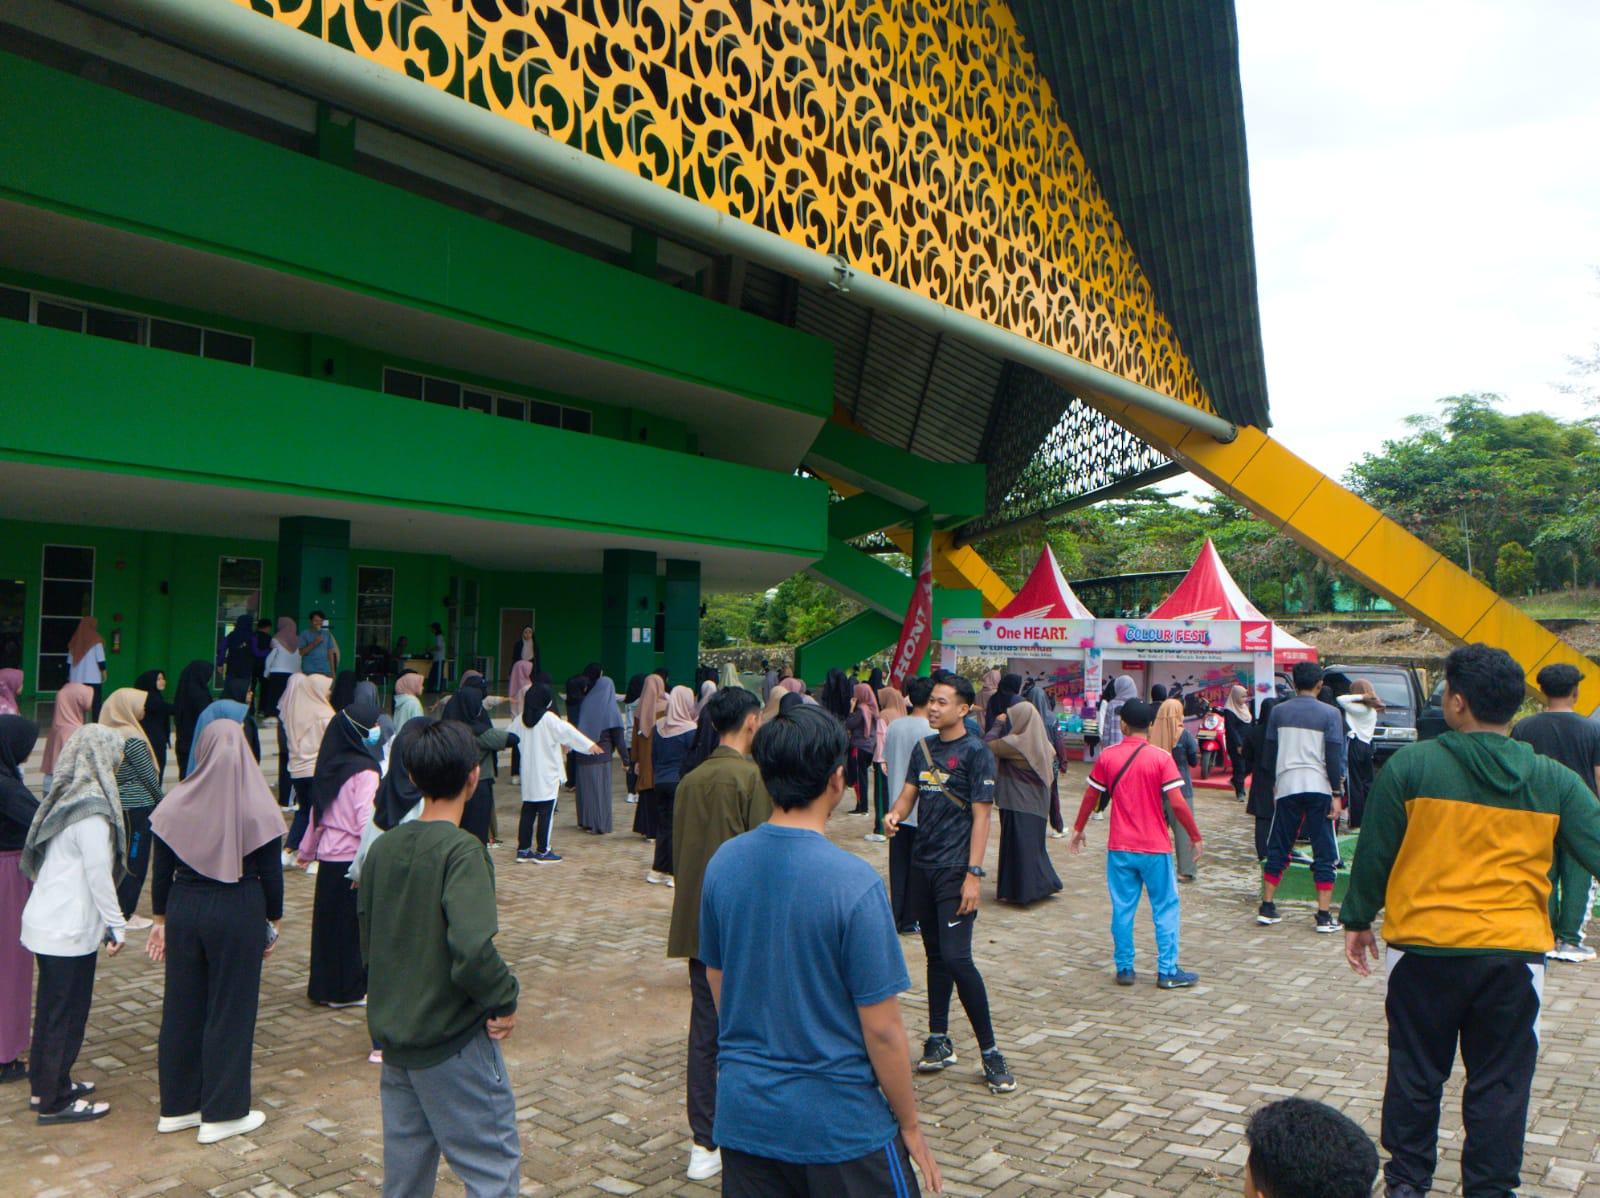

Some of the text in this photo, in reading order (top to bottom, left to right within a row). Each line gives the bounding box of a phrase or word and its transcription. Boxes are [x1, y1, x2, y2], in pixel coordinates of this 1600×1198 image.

[996, 626, 1021, 639] One
[1023, 626, 1068, 640] HEART.
[1126, 628, 1208, 643] COLOUR FEST
